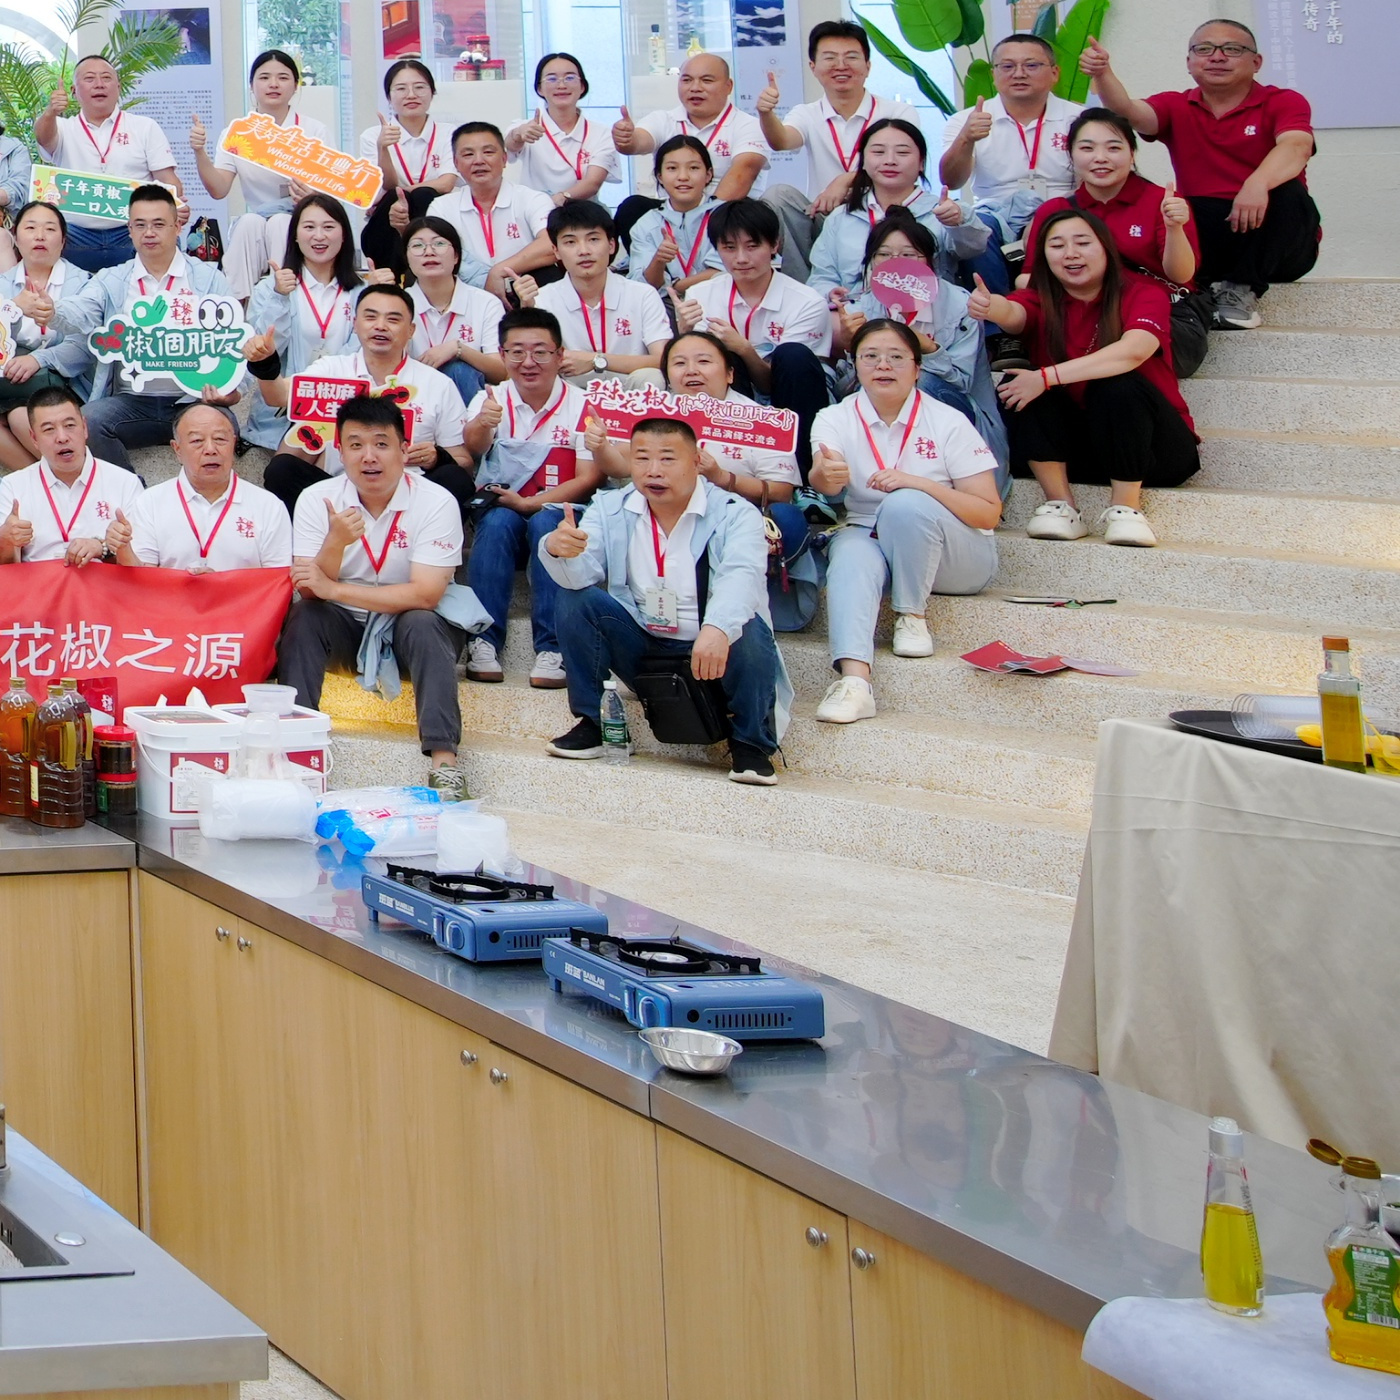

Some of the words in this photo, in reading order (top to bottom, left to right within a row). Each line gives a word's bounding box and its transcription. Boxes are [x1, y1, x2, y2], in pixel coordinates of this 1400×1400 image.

[236, 118, 315, 158] 美好生活
[311, 151, 376, 188] 五豐行
[267, 146, 293, 162] What
[274, 159, 325, 184] Wonderful
[326, 178, 346, 193] Life
[61, 179, 121, 200] 千年贡椒
[72, 201, 130, 219] 一口入魂
[125, 329, 244, 360] 椒個朋友
[297, 381, 356, 400] 品椒麻
[583, 381, 673, 414] 寻味花椒
[701, 426, 777, 446] 菜品演绎交流会
